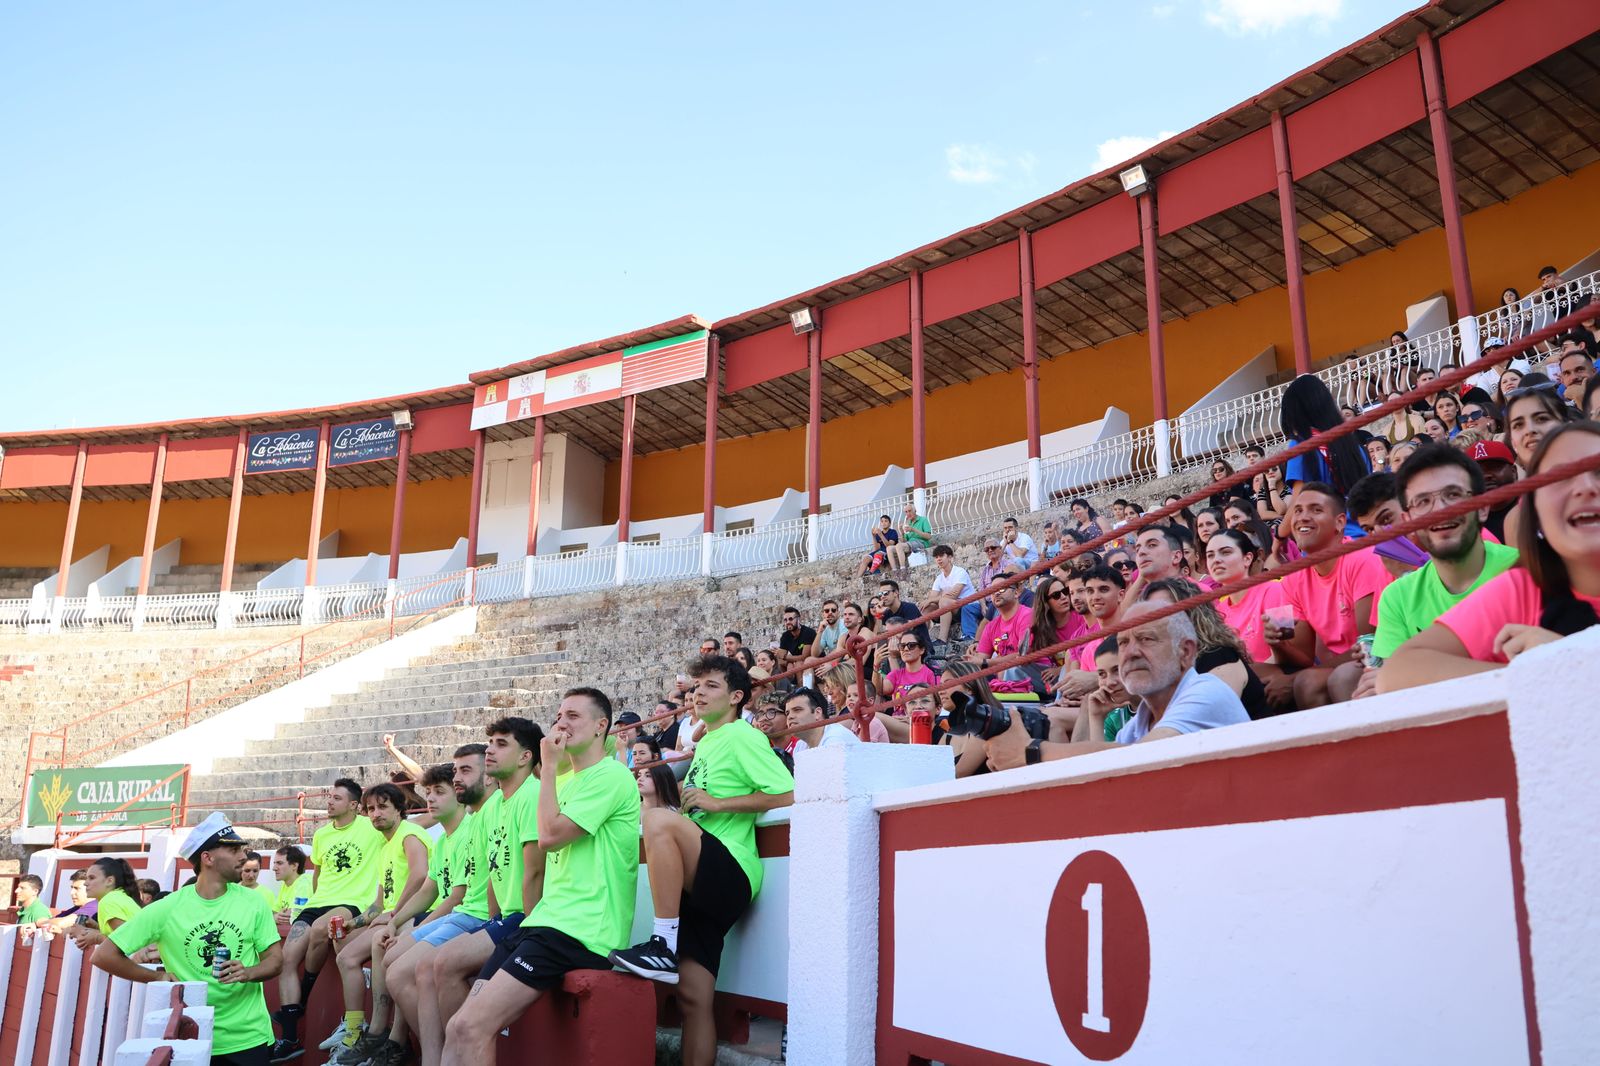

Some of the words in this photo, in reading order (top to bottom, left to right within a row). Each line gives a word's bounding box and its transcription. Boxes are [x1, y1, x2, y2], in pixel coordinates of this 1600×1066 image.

[252, 437, 270, 457] La
[335, 428, 352, 449] La
[1474, 442, 1488, 459] A
[77, 781, 113, 804] CAJA
[117, 779, 175, 803] RURAL
[76, 811, 88, 821] DE
[184, 923, 206, 946] SUPER
[224, 921, 244, 938] GRAN
[1081, 883, 1111, 1033] 1
